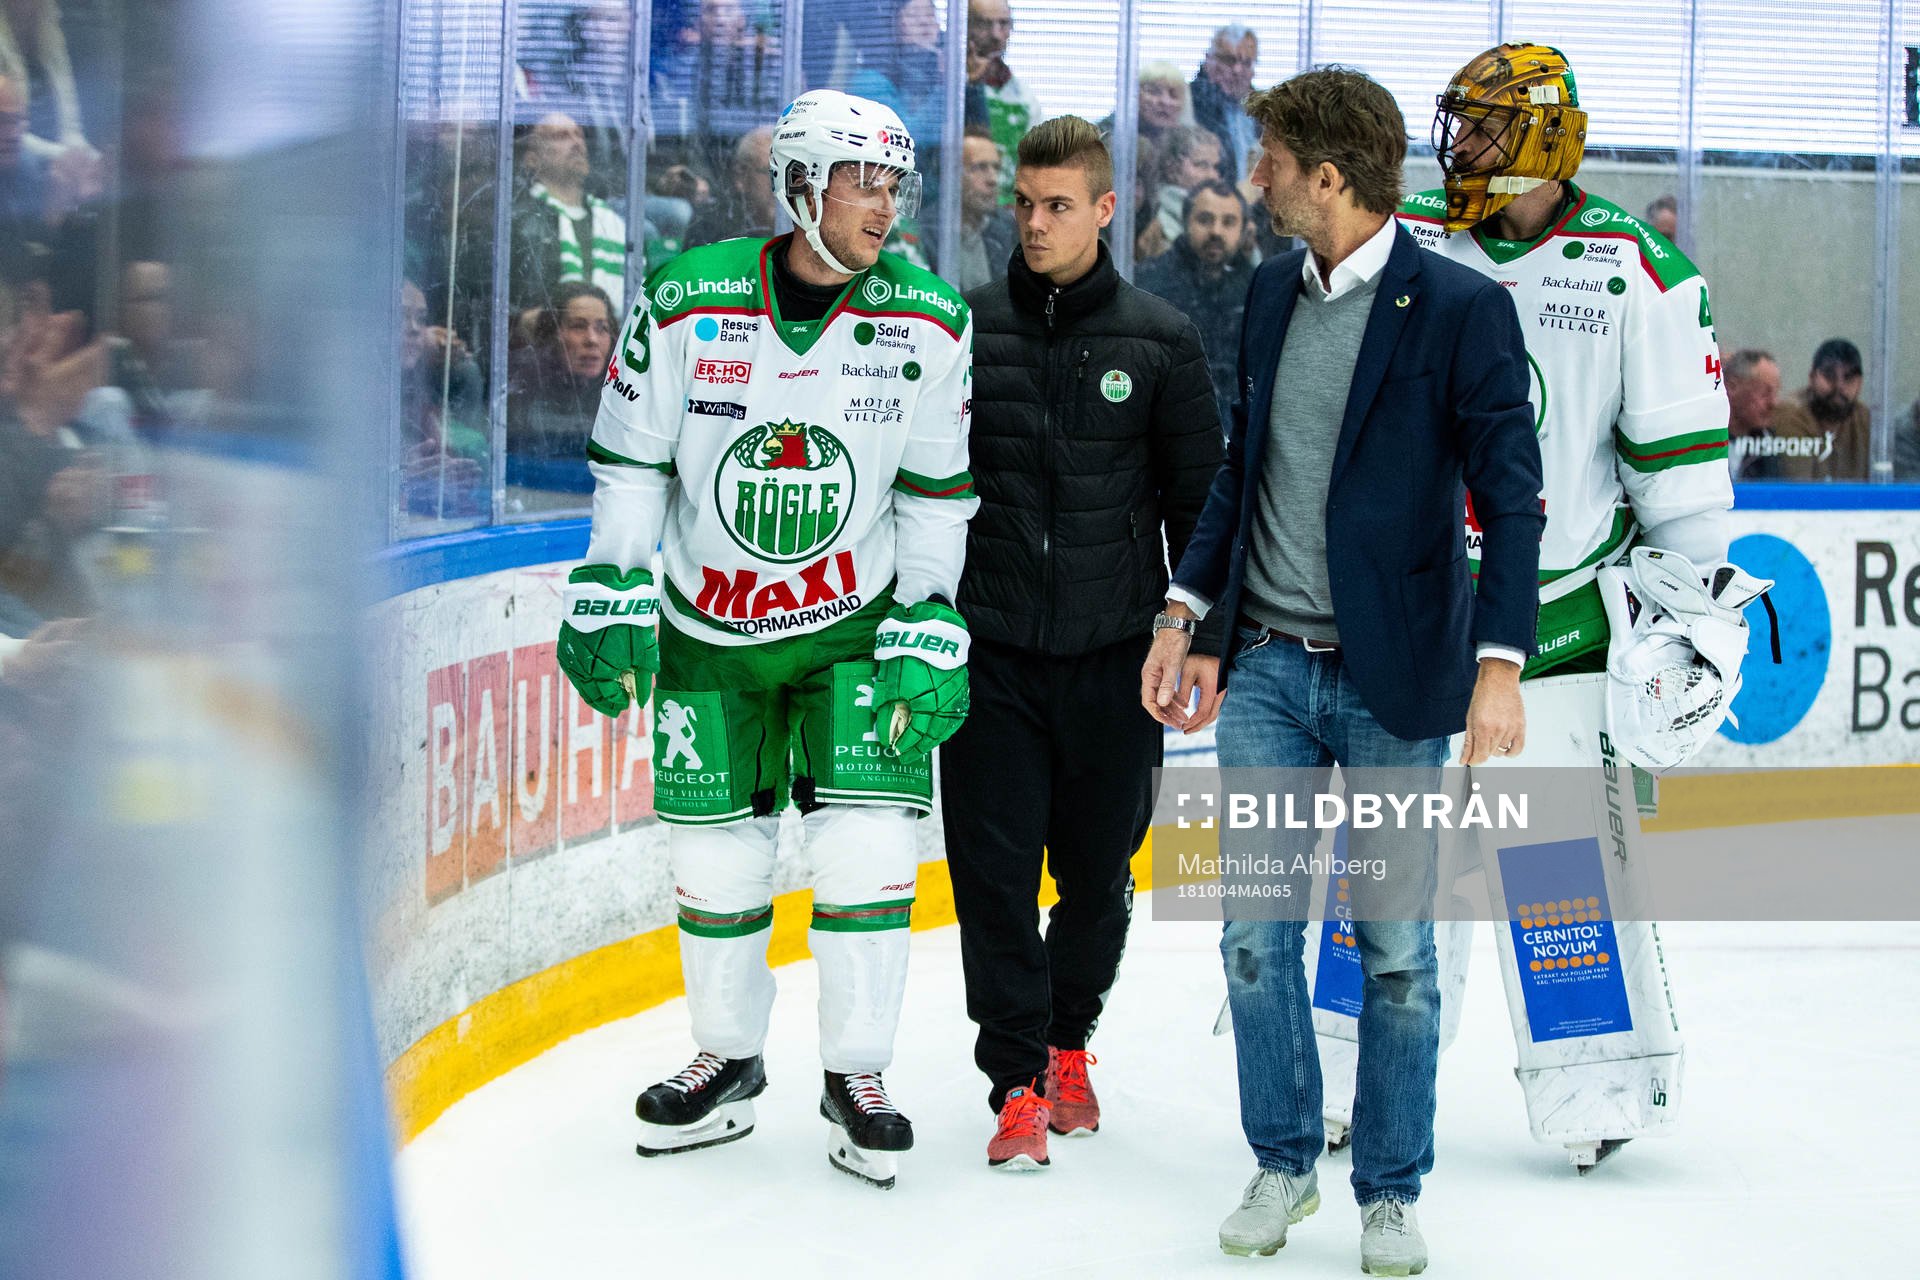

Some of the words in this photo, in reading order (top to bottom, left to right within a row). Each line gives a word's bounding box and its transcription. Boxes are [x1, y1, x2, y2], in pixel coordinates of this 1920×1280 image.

[1586, 242, 1618, 255] Solid
[1541, 276, 1603, 292] Backahill
[1545, 303, 1606, 319] MOTOR
[877, 323, 910, 339] Solid
[1539, 317, 1609, 336] VILLAGE
[720, 331, 749, 343] Bank
[875, 337, 917, 353] Försäkring
[697, 362, 747, 377] ER-HO
[841, 363, 899, 378] Backahill
[708, 375, 735, 384] BYGG
[850, 397, 901, 409] MOTOR
[844, 411, 903, 424] VILLAGE
[734, 476, 840, 555] RÖGLE
[695, 550, 858, 620] MAXI
[835, 763, 882, 772] MOTOR
[891, 764, 929, 777] VILLAGE
[1533, 940, 1597, 958] NOVUM
